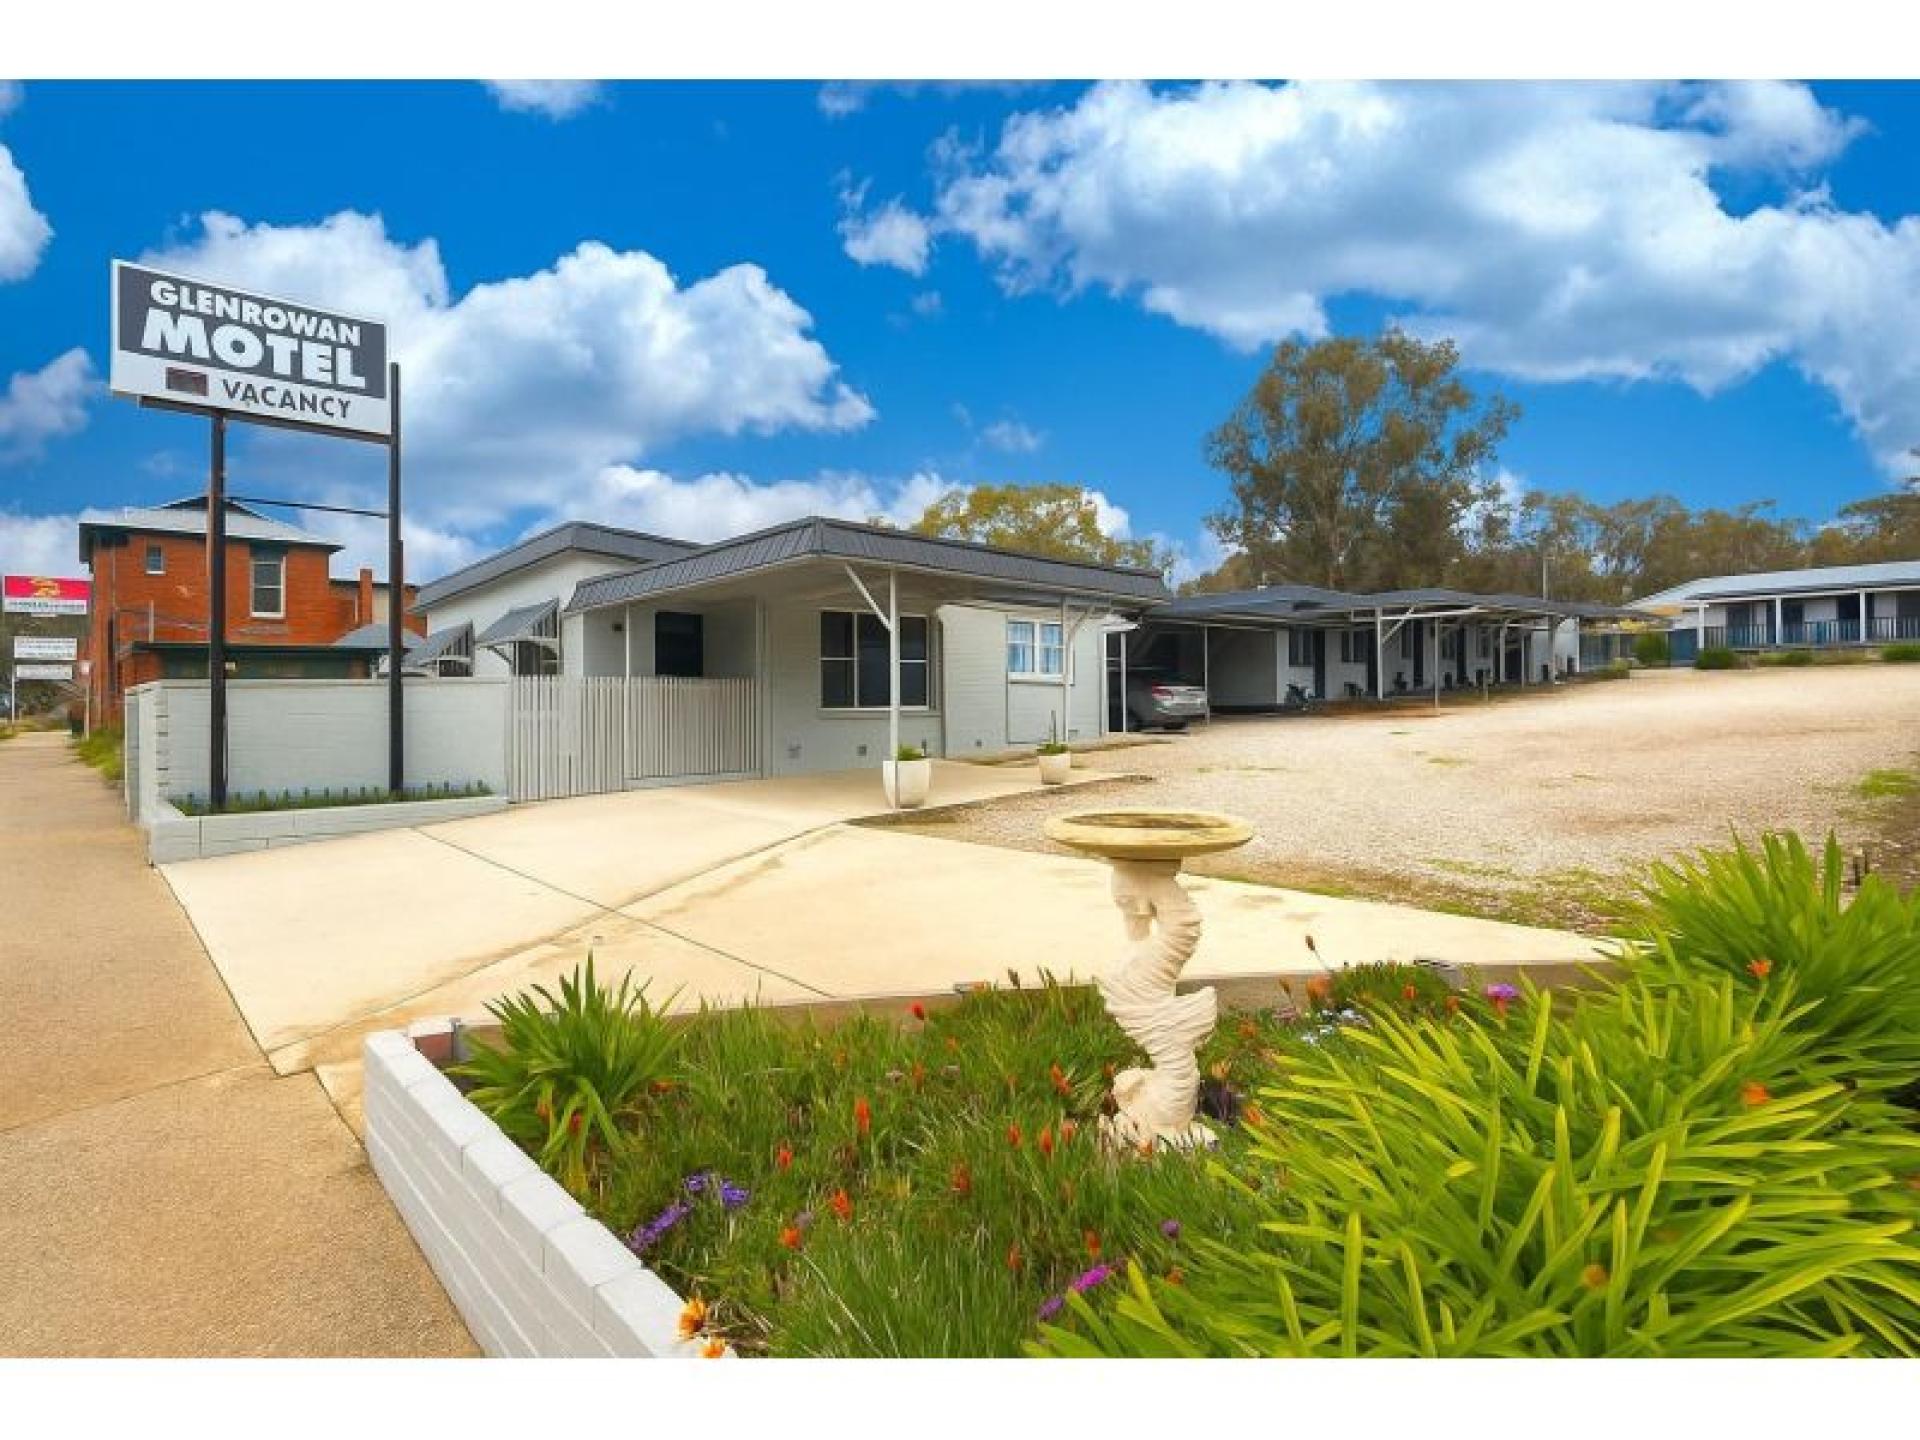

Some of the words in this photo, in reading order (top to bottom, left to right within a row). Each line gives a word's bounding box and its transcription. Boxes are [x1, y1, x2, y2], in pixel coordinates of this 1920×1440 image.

[150, 280, 361, 347] GLENROWAN
[141, 306, 366, 389] MOTEL
[223, 378, 351, 419] VACANCY
